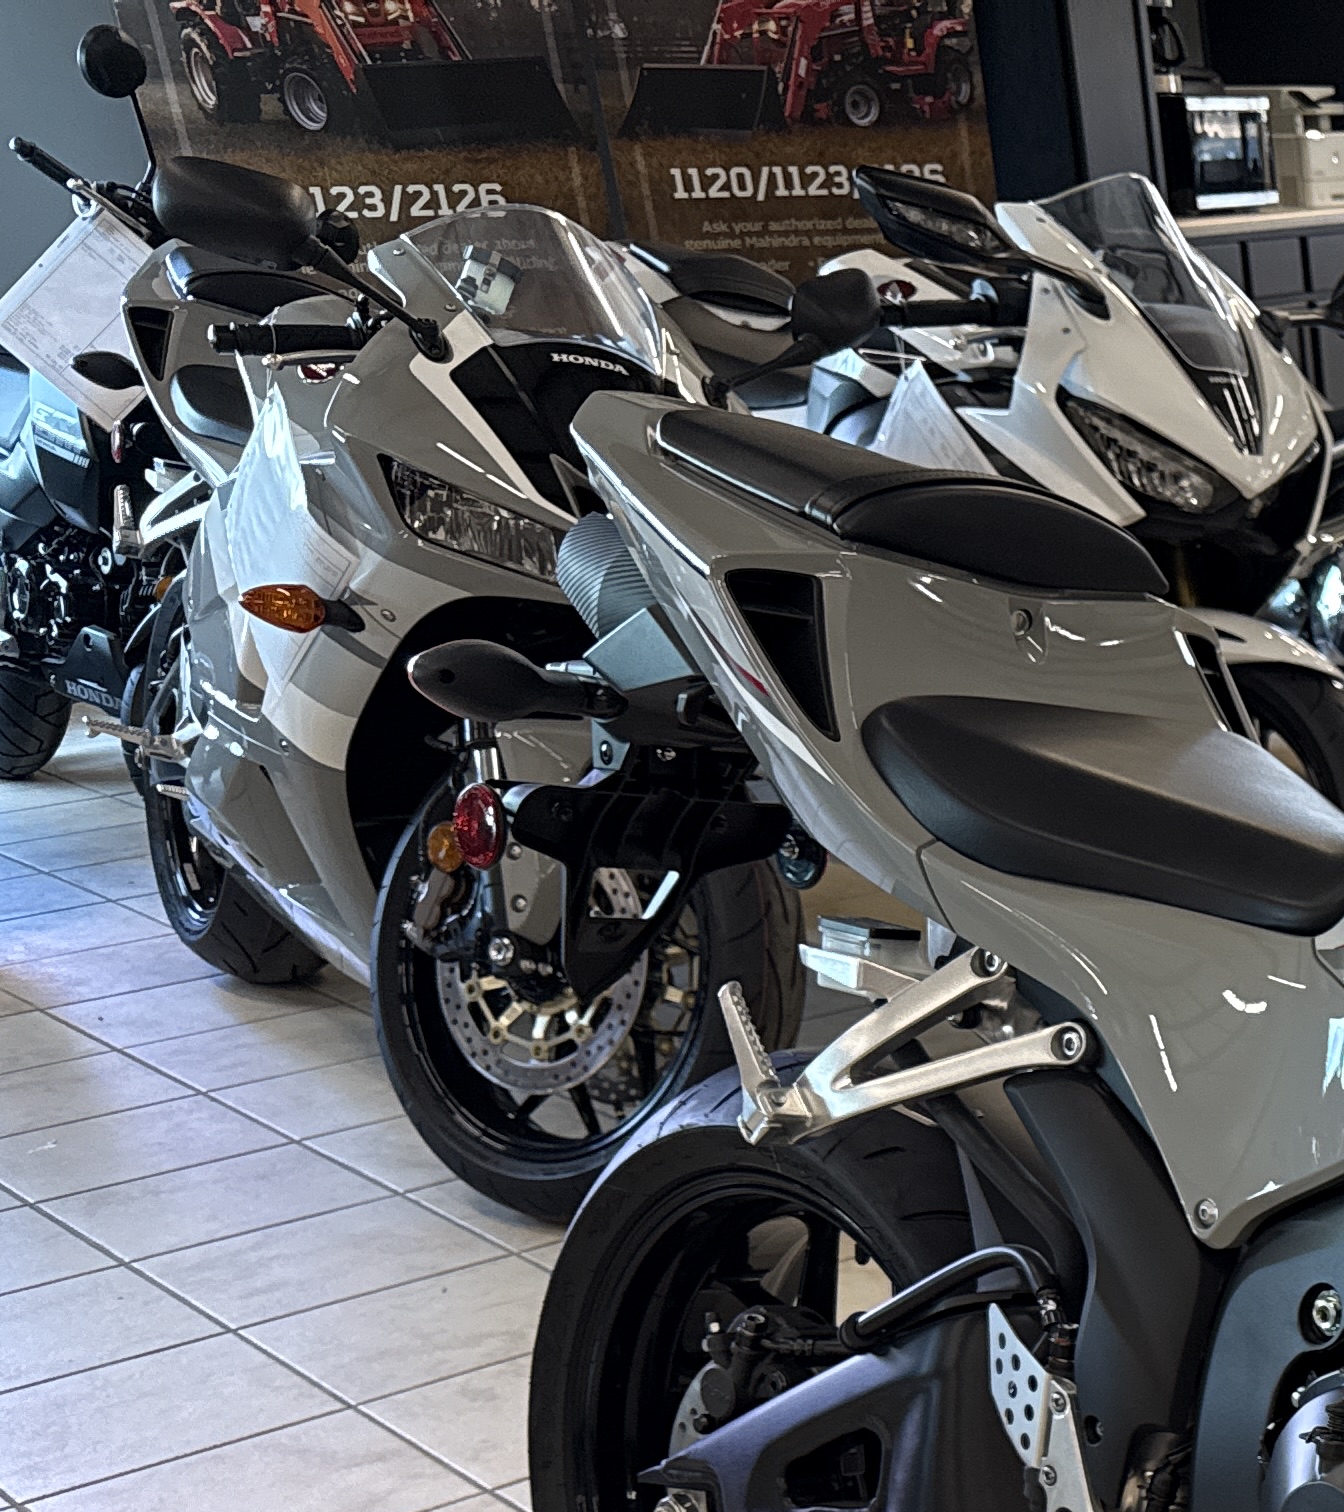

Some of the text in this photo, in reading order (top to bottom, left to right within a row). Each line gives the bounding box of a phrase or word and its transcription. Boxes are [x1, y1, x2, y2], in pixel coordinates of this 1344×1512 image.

[308, 182, 507, 222] 123/2126
[703, 220, 730, 233] Ask
[732, 221, 764, 234] your
[768, 217, 843, 231] authorized
[744, 233, 810, 249] Mahindra
[550, 353, 630, 376] HONDA
